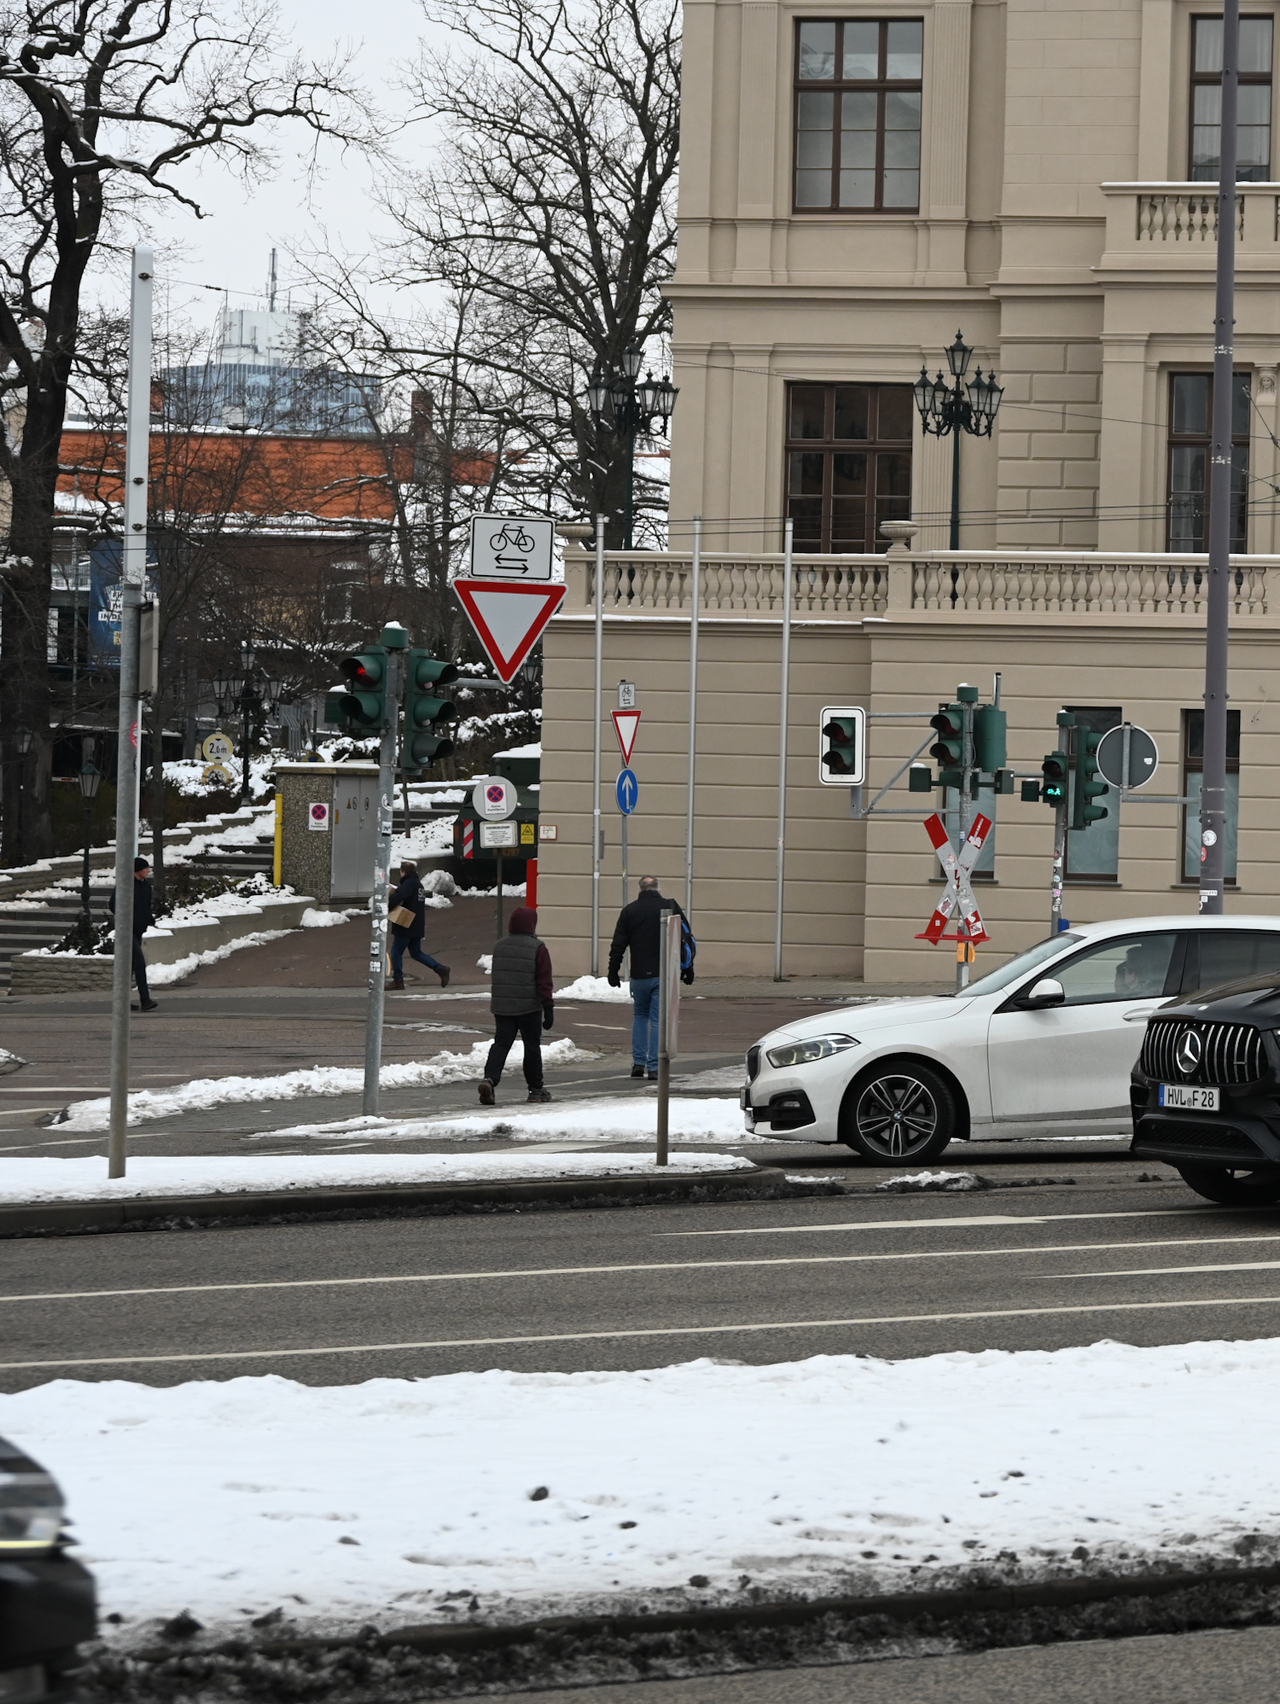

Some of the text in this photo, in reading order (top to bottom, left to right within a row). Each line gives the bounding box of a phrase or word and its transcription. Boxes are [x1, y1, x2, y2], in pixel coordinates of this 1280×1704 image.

[1168, 1088, 1214, 1108] HVL F 28
